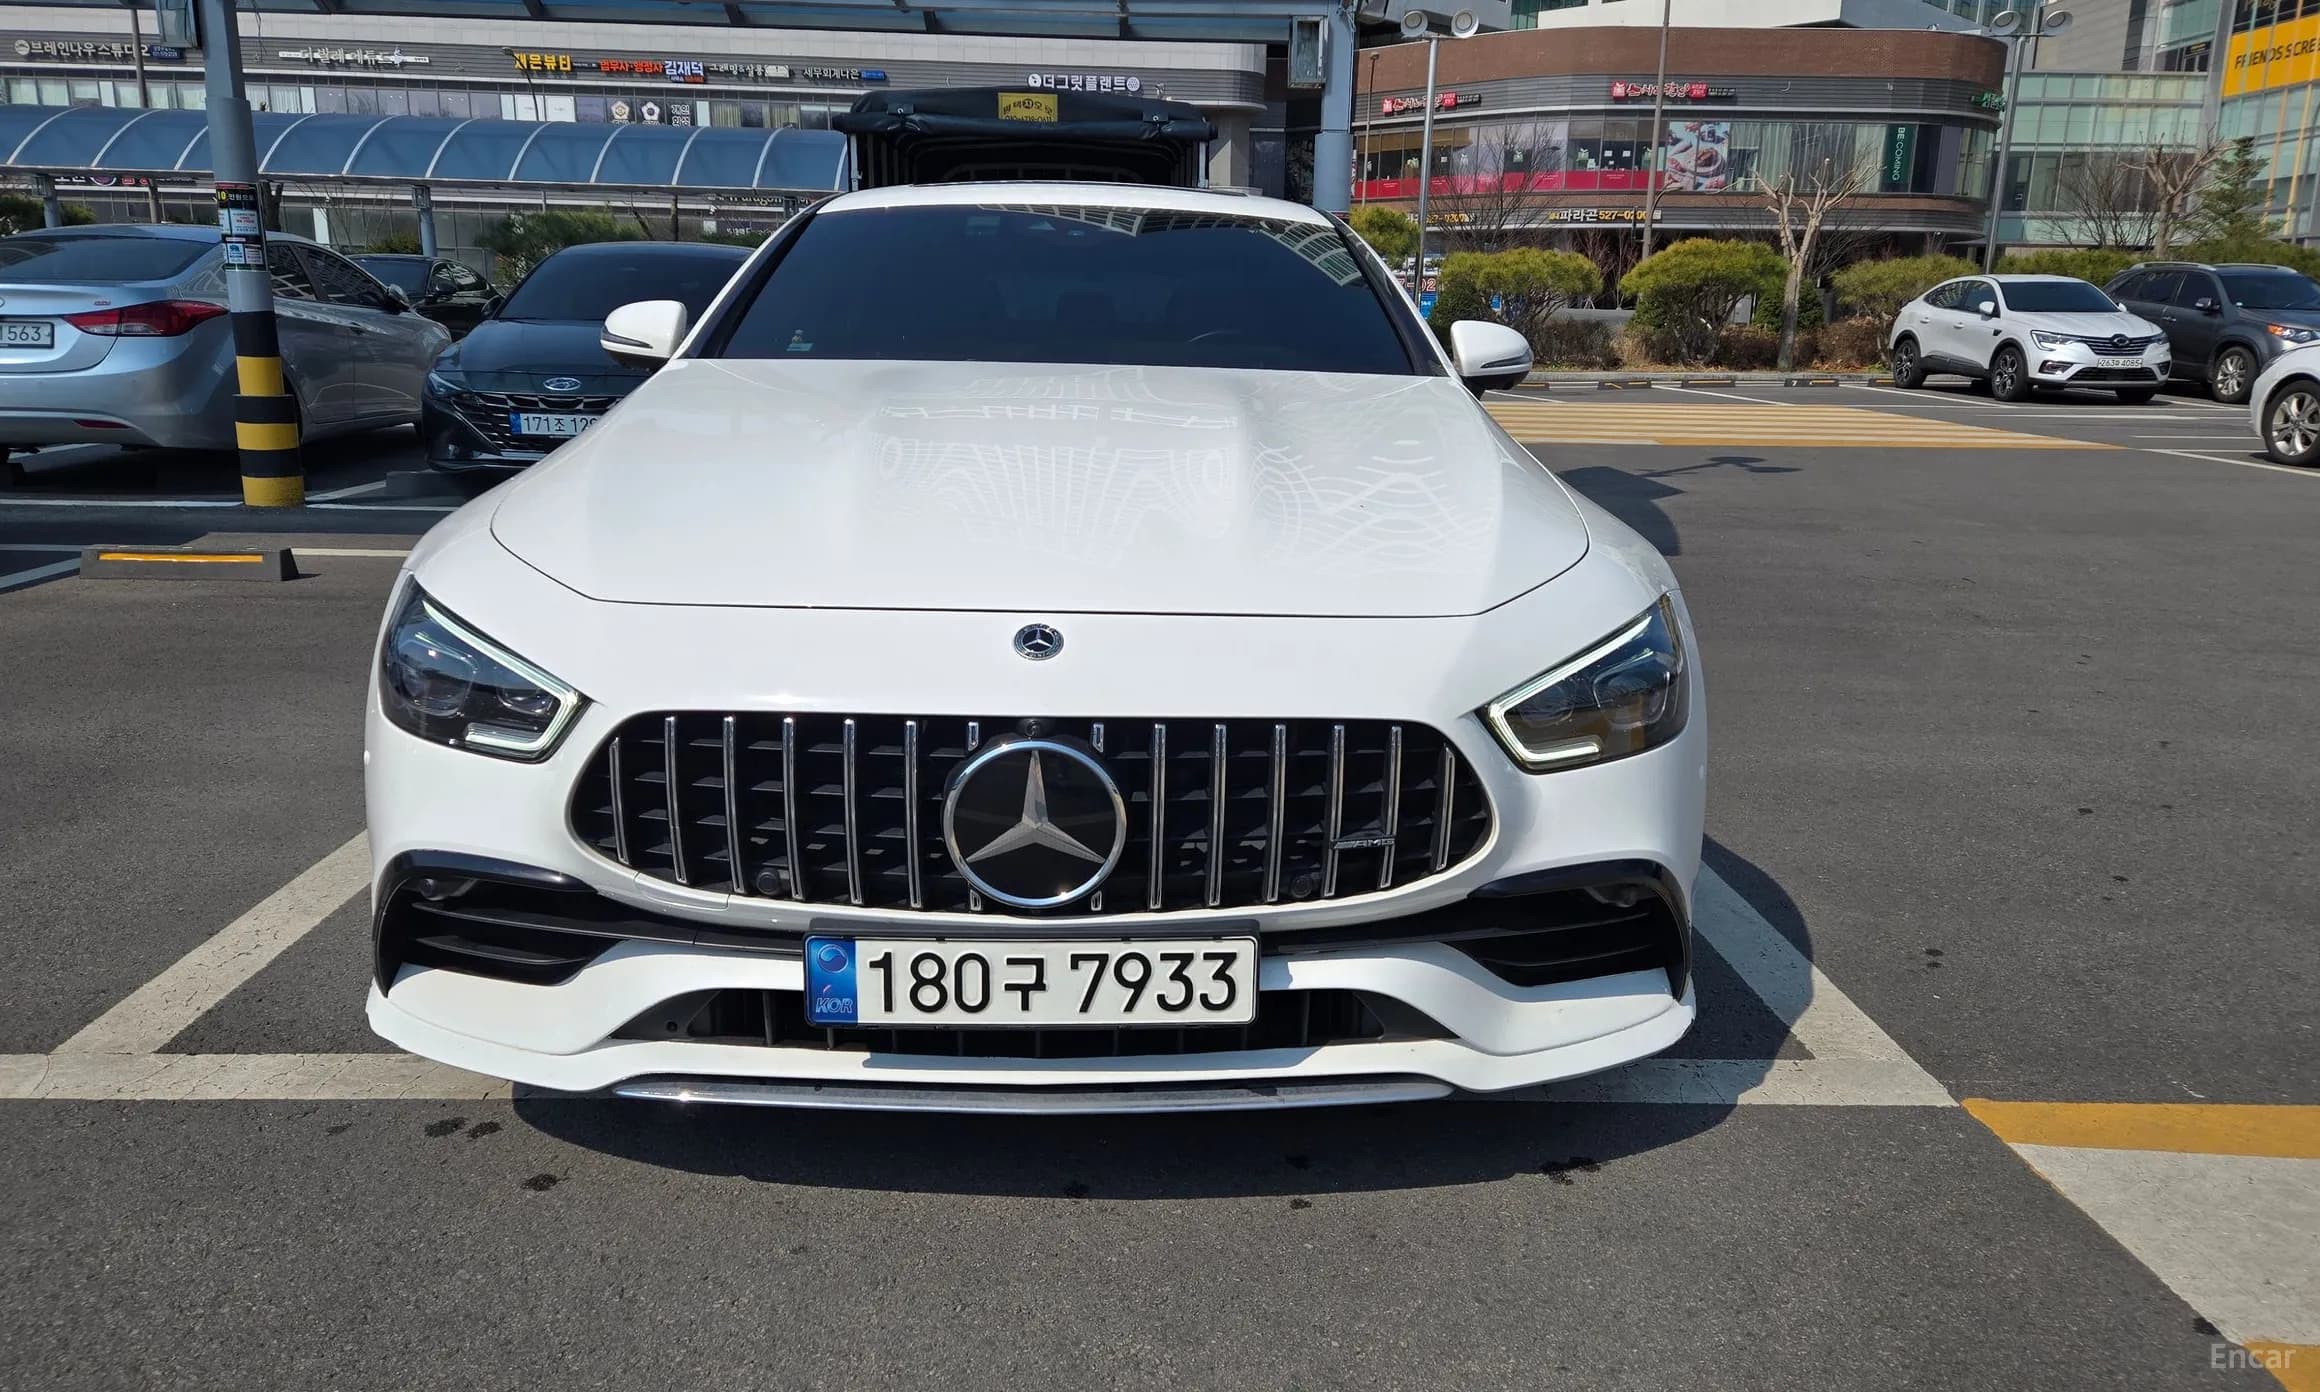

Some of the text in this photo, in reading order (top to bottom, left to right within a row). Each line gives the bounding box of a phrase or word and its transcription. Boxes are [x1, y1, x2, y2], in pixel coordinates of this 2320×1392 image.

[1043, 74, 1126, 92] 더그릿플랜트
[523, 415, 566, 432] 171조
[868, 951, 1239, 1014] 180구 7933
[815, 997, 853, 1014] KOR
